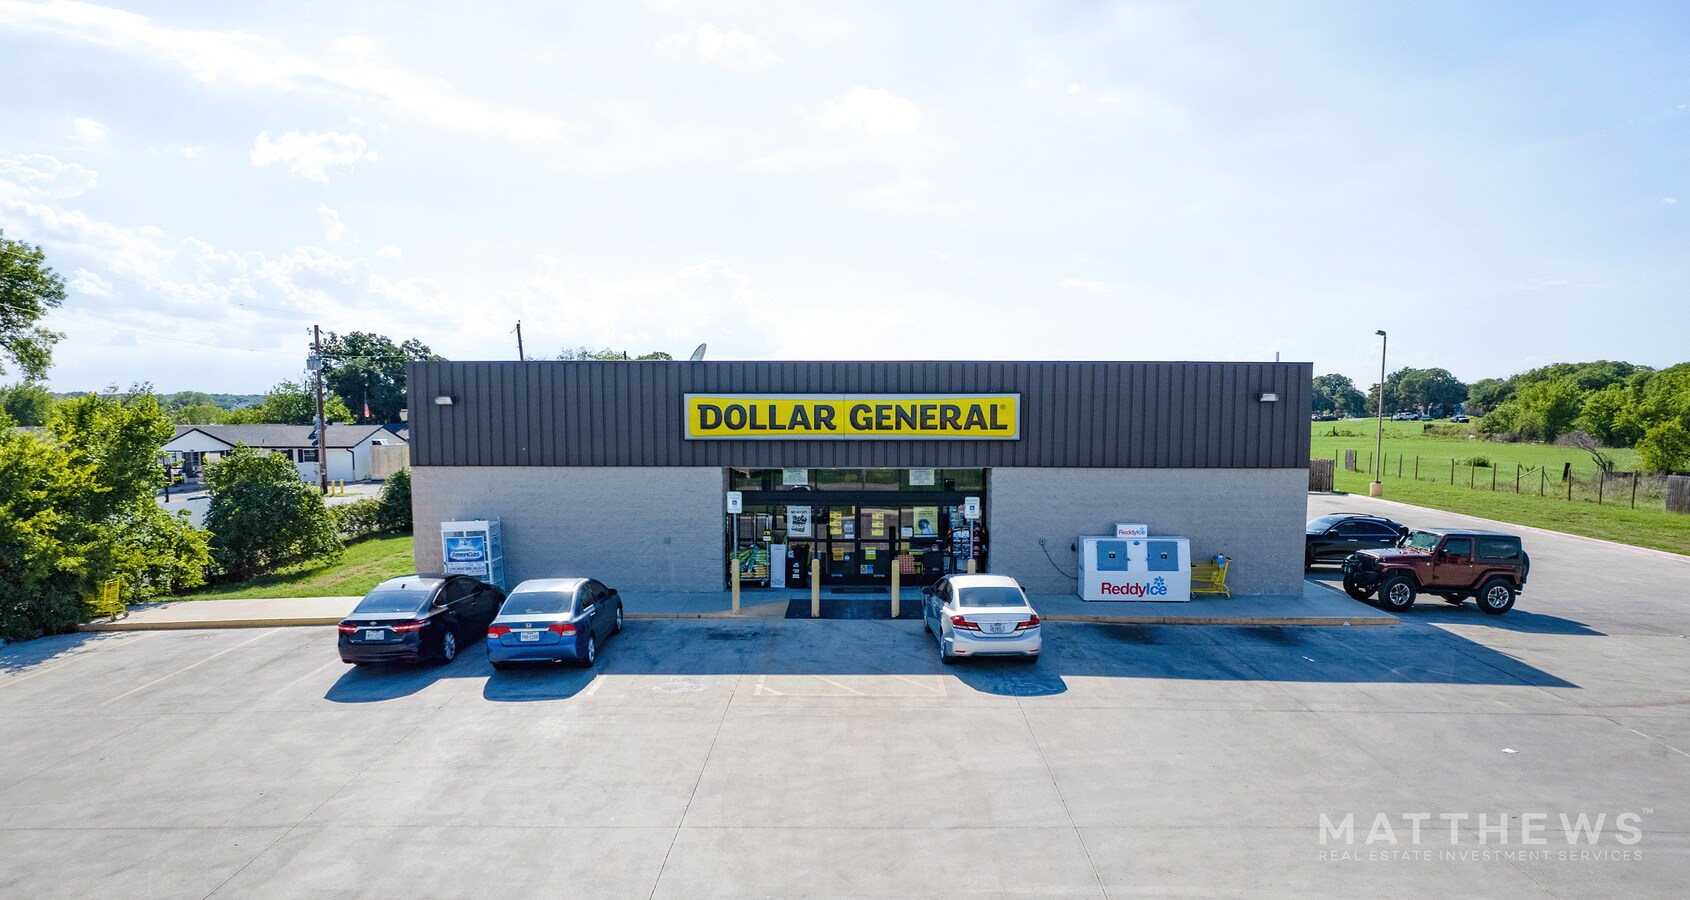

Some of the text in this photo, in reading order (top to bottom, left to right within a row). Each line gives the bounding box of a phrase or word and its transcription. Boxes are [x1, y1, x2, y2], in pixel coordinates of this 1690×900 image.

[697, 404, 1008, 430] DOLLAR GENERAL
[1118, 528, 1146, 536] ReddyIce
[1101, 582, 1167, 597] ReddyIce
